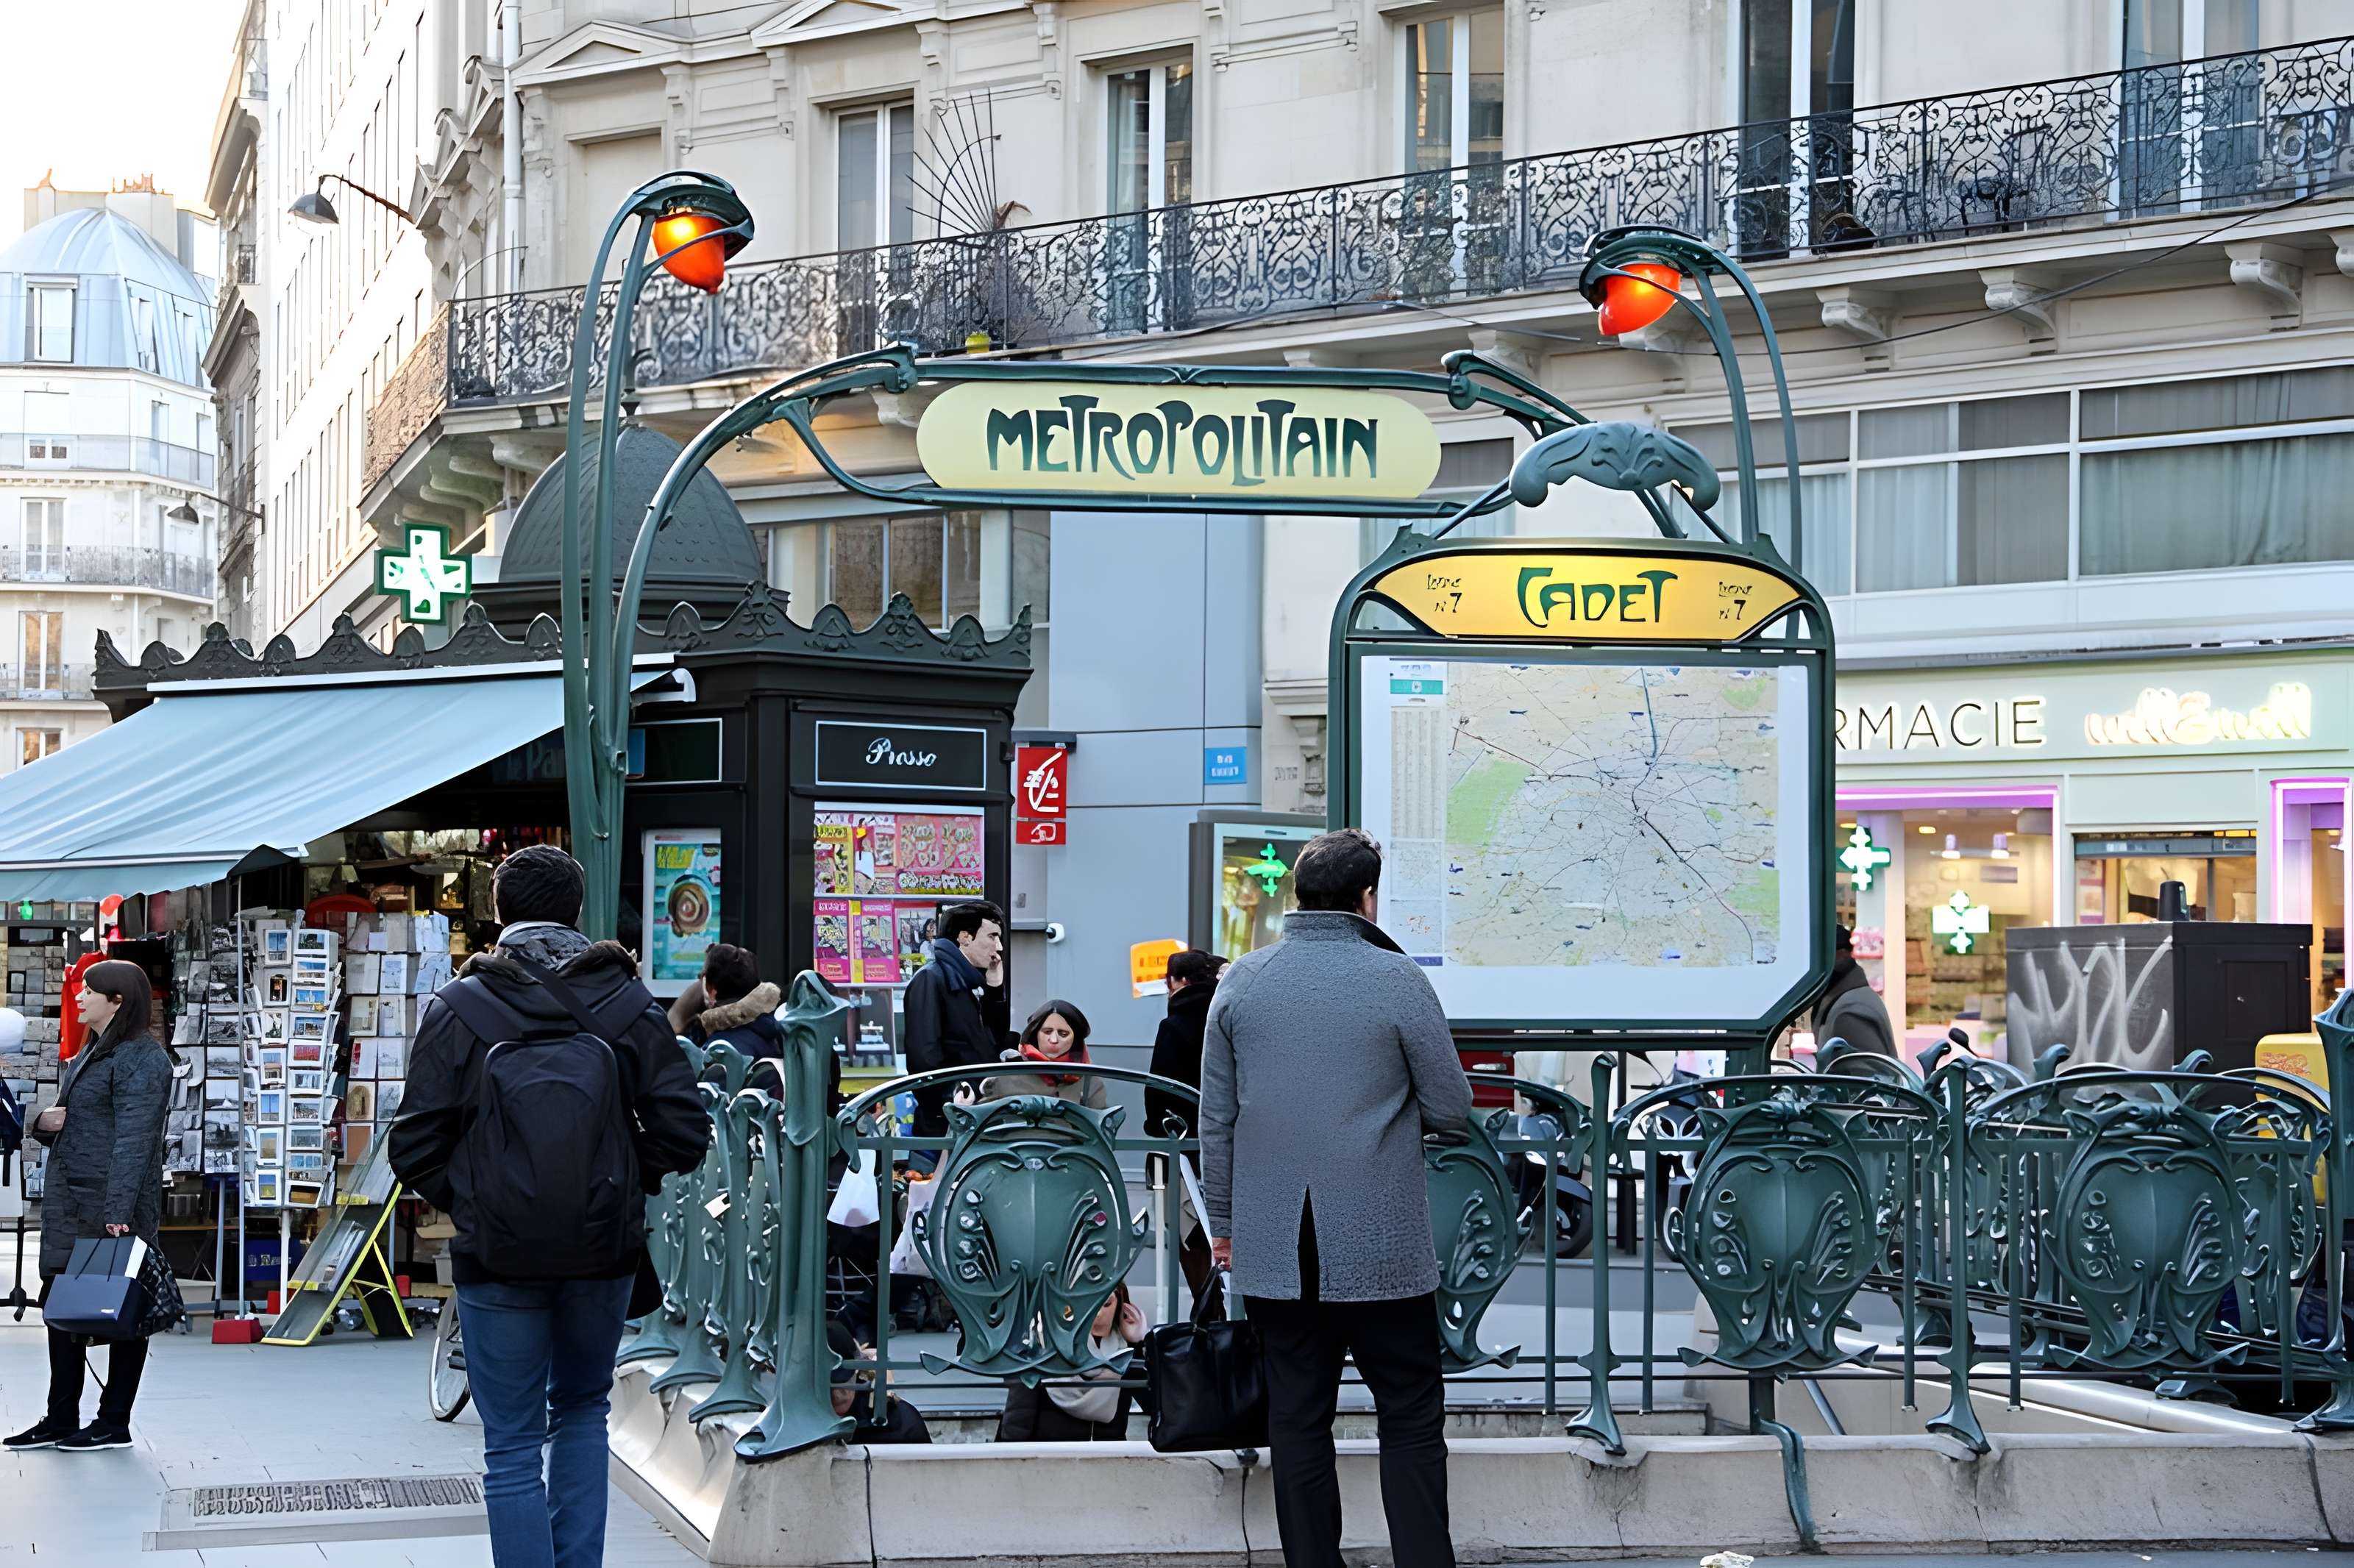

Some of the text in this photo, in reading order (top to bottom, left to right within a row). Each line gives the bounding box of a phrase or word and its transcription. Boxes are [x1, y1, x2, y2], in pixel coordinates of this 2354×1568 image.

[986, 394, 1379, 487] METROPOLITAIN
[1449, 592, 1462, 613] 7
[1518, 566, 1679, 629] CADET
[1734, 599, 1746, 620] 7
[1835, 699, 2044, 749] RMACIE
